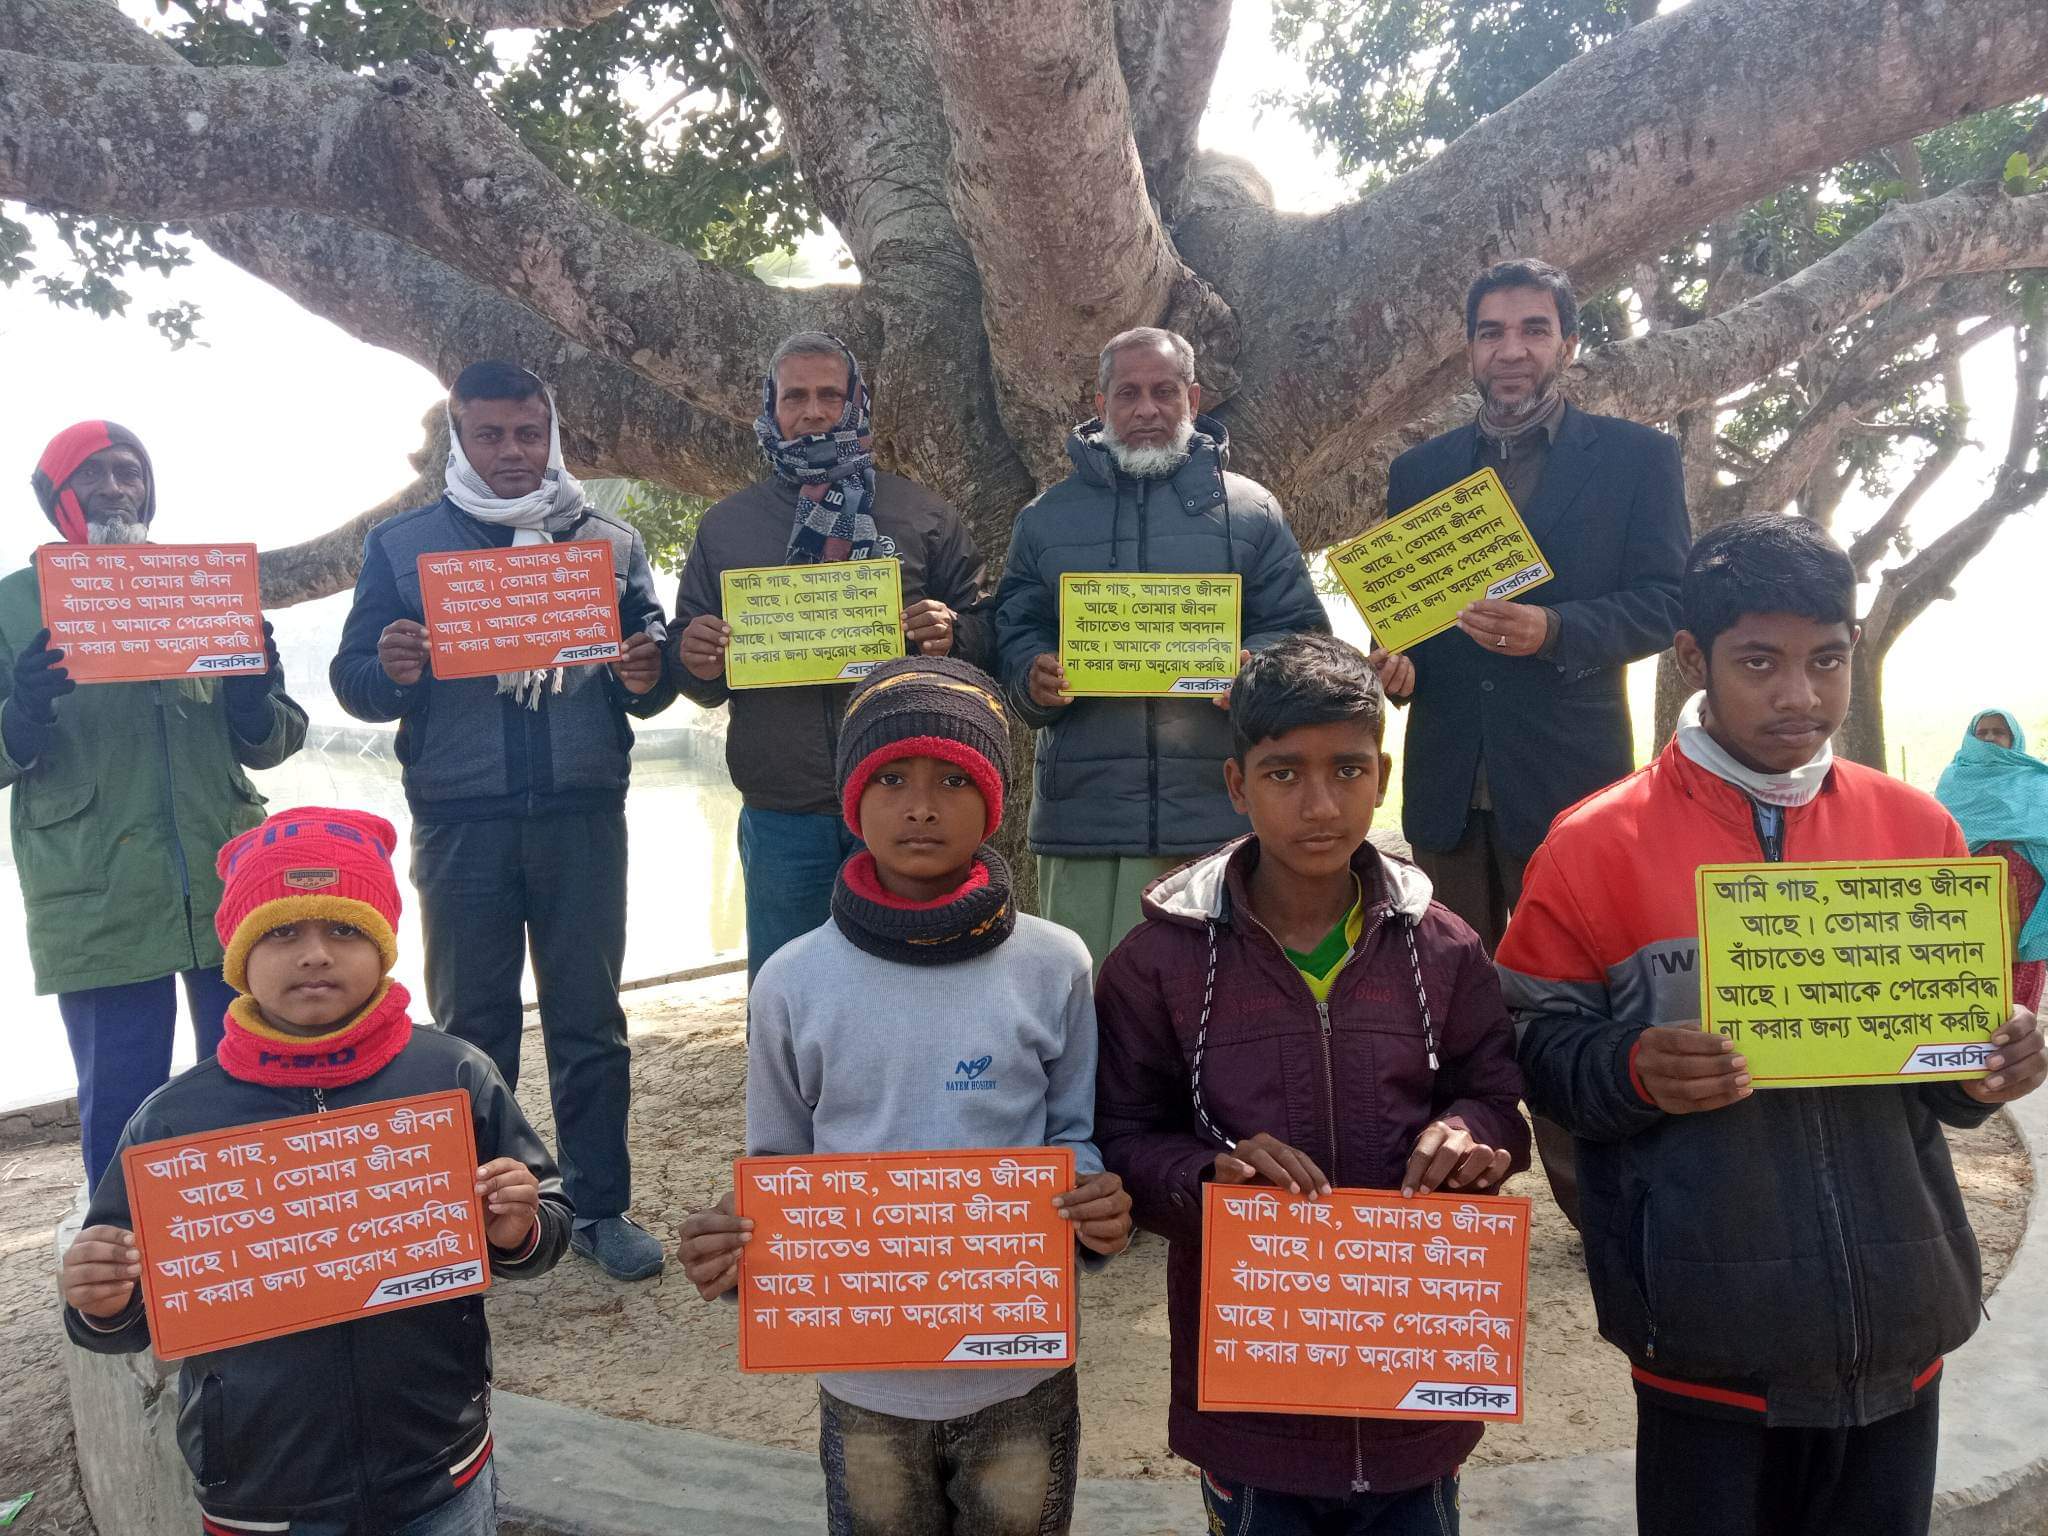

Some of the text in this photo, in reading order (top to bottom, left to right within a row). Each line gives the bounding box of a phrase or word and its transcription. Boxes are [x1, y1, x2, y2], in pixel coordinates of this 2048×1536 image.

[1338, 545, 1369, 564] আমি
[1401, 502, 1452, 531] আমারও
[1453, 481, 1491, 504] জীবন
[1406, 505, 1487, 554] তোমার জীবন
[50, 553, 90, 570] আমি
[139, 555, 199, 568] আমারও
[205, 550, 247, 567] জীবন
[428, 559, 463, 575] আমি
[506, 554, 560, 568] আমারও
[565, 547, 603, 563] জীবন
[1363, 517, 1505, 594] বাঁচাতেও আমার অবদান
[132, 570, 232, 589] তোমার জীবন
[501, 568, 590, 589] তোমার জীবন
[731, 574, 762, 590] আমি
[801, 572, 851, 585] আমারও
[856, 566, 891, 581] জীবন
[1070, 580, 1101, 595] আমি
[1141, 584, 1190, 596] আমারও
[1196, 581, 1232, 597] জীবন
[1407, 565, 1453, 592] আমাকে
[1488, 566, 1541, 594] বারসিক
[62, 593, 244, 612] বাঁচাতেও আমার অবদান
[441, 587, 601, 614] বাঁচাতেও আমার অবদান
[795, 585, 878, 604] তোমার জীবন
[1133, 599, 1217, 615] তোমার জীবন
[1376, 567, 1493, 630] না করার জন্য অনুরোধ
[112, 618, 171, 632] আমাকে
[485, 614, 537, 629] আমাকে
[739, 605, 888, 626] বাঁচাতেও আমার অবদান
[1076, 617, 1226, 634] বাঁচাতেও আমার অবদান
[78, 637, 208, 655] করার জন্য অনুরোধ
[439, 630, 571, 655] না করার জন্য অনুরোধ
[778, 629, 826, 643] আমাকে
[1113, 640, 1161, 653] আমাকে
[197, 656, 259, 669] বারসিক
[561, 645, 616, 659] বারসিক
[734, 645, 857, 665] না করার জন্য অনুরোধ
[1067, 659, 1191, 675] না করার জন্য অনুরোধ
[1712, 875, 1768, 902] আমি
[1836, 878, 1922, 899] আমারও
[1930, 870, 1990, 897] জীবন
[1826, 911, 1901, 934] তোমার
[1908, 903, 1969, 931] জীবন
[1728, 941, 1985, 971] বাঁচাতেও আমার অবদান
[1798, 981, 1881, 1004] আমাকে
[1720, 1020, 1743, 1042] না
[1750, 1018, 1803, 1040] করার
[1809, 1018, 1850, 1038] জন্য
[1857, 1013, 1933, 1041] অনুরোধ
[145, 1149, 207, 1179] আমি
[284, 1123, 379, 1153] আমারও
[388, 1108, 453, 1134] জীবন
[274, 1159, 357, 1191] তোমার
[364, 1144, 431, 1171] জীবন
[754, 1167, 813, 1194] আমি
[887, 1169, 981, 1191] আমারও
[991, 1161, 1059, 1188] জীবন
[167, 1171, 451, 1243] বাঁচাতেও আমার অবদান
[873, 1203, 956, 1225] তোমার
[964, 1194, 1031, 1222] জীবন
[1223, 1194, 1280, 1222] আমি
[1352, 1206, 1441, 1230] আমারও
[1452, 1204, 1516, 1235] জীবন
[246, 1228, 338, 1260] আমাকে
[767, 1232, 1047, 1261] বাঁচাতেও আমার অবদান
[1336, 1240, 1416, 1264] তোমার
[1423, 1237, 1488, 1268] জীবন
[162, 1291, 188, 1313] না
[195, 1278, 254, 1306] করার
[261, 1267, 307, 1291] জন্য
[314, 1248, 397, 1281] অনুরোধ
[381, 1267, 477, 1296] বারসিক
[839, 1271, 929, 1293] আমাকে
[1231, 1261, 1502, 1302] বাঁচাতেও আমার অবদান
[755, 1308, 779, 1329] না
[786, 1307, 842, 1328] করার
[849, 1307, 894, 1327] জন্য
[901, 1303, 984, 1330] অনুরোধ
[1299, 1308, 1386, 1332] আমাকে
[964, 1334, 1061, 1354] বারসিক
[1214, 1339, 1238, 1361] না
[1245, 1341, 1300, 1363] করার
[1306, 1344, 1350, 1367] জন্য
[1357, 1347, 1437, 1374] অনুরোধ
[1415, 1383, 1510, 1405] বারসিক
